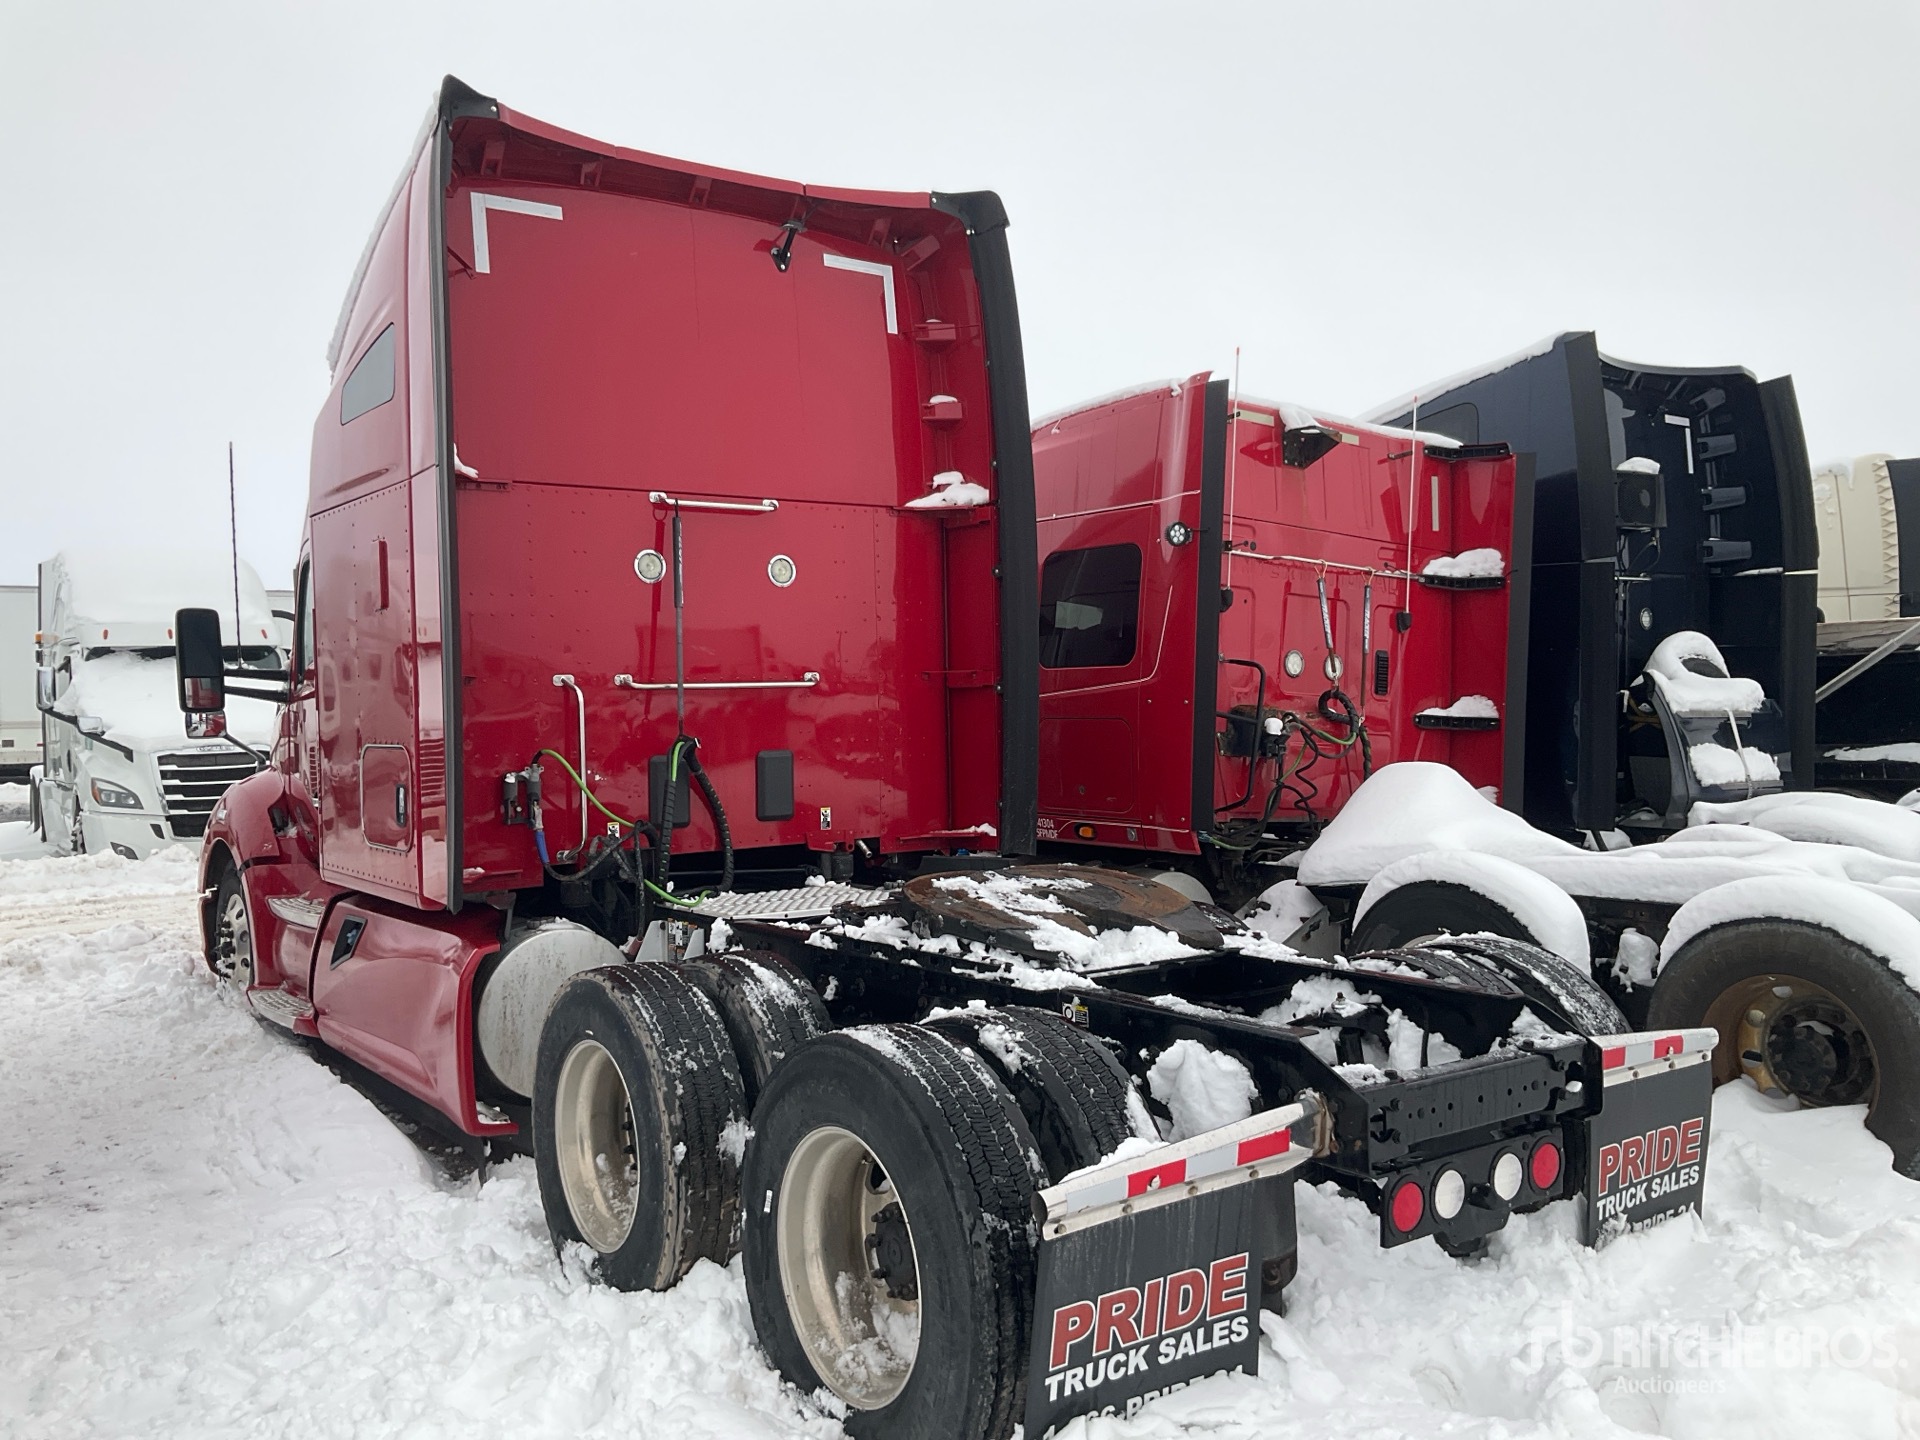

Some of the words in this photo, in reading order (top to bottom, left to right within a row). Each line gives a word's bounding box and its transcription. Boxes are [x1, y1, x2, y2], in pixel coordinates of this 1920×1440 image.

[1597, 1182, 1648, 1221] TRUCK
[1651, 1166, 1700, 1198] SALES
[1598, 1117, 1703, 1197] PRIDE
[1049, 1252, 1249, 1371] PRIDE
[1044, 1345, 1150, 1402] TRUCK
[1158, 1316, 1249, 1365] SALES
